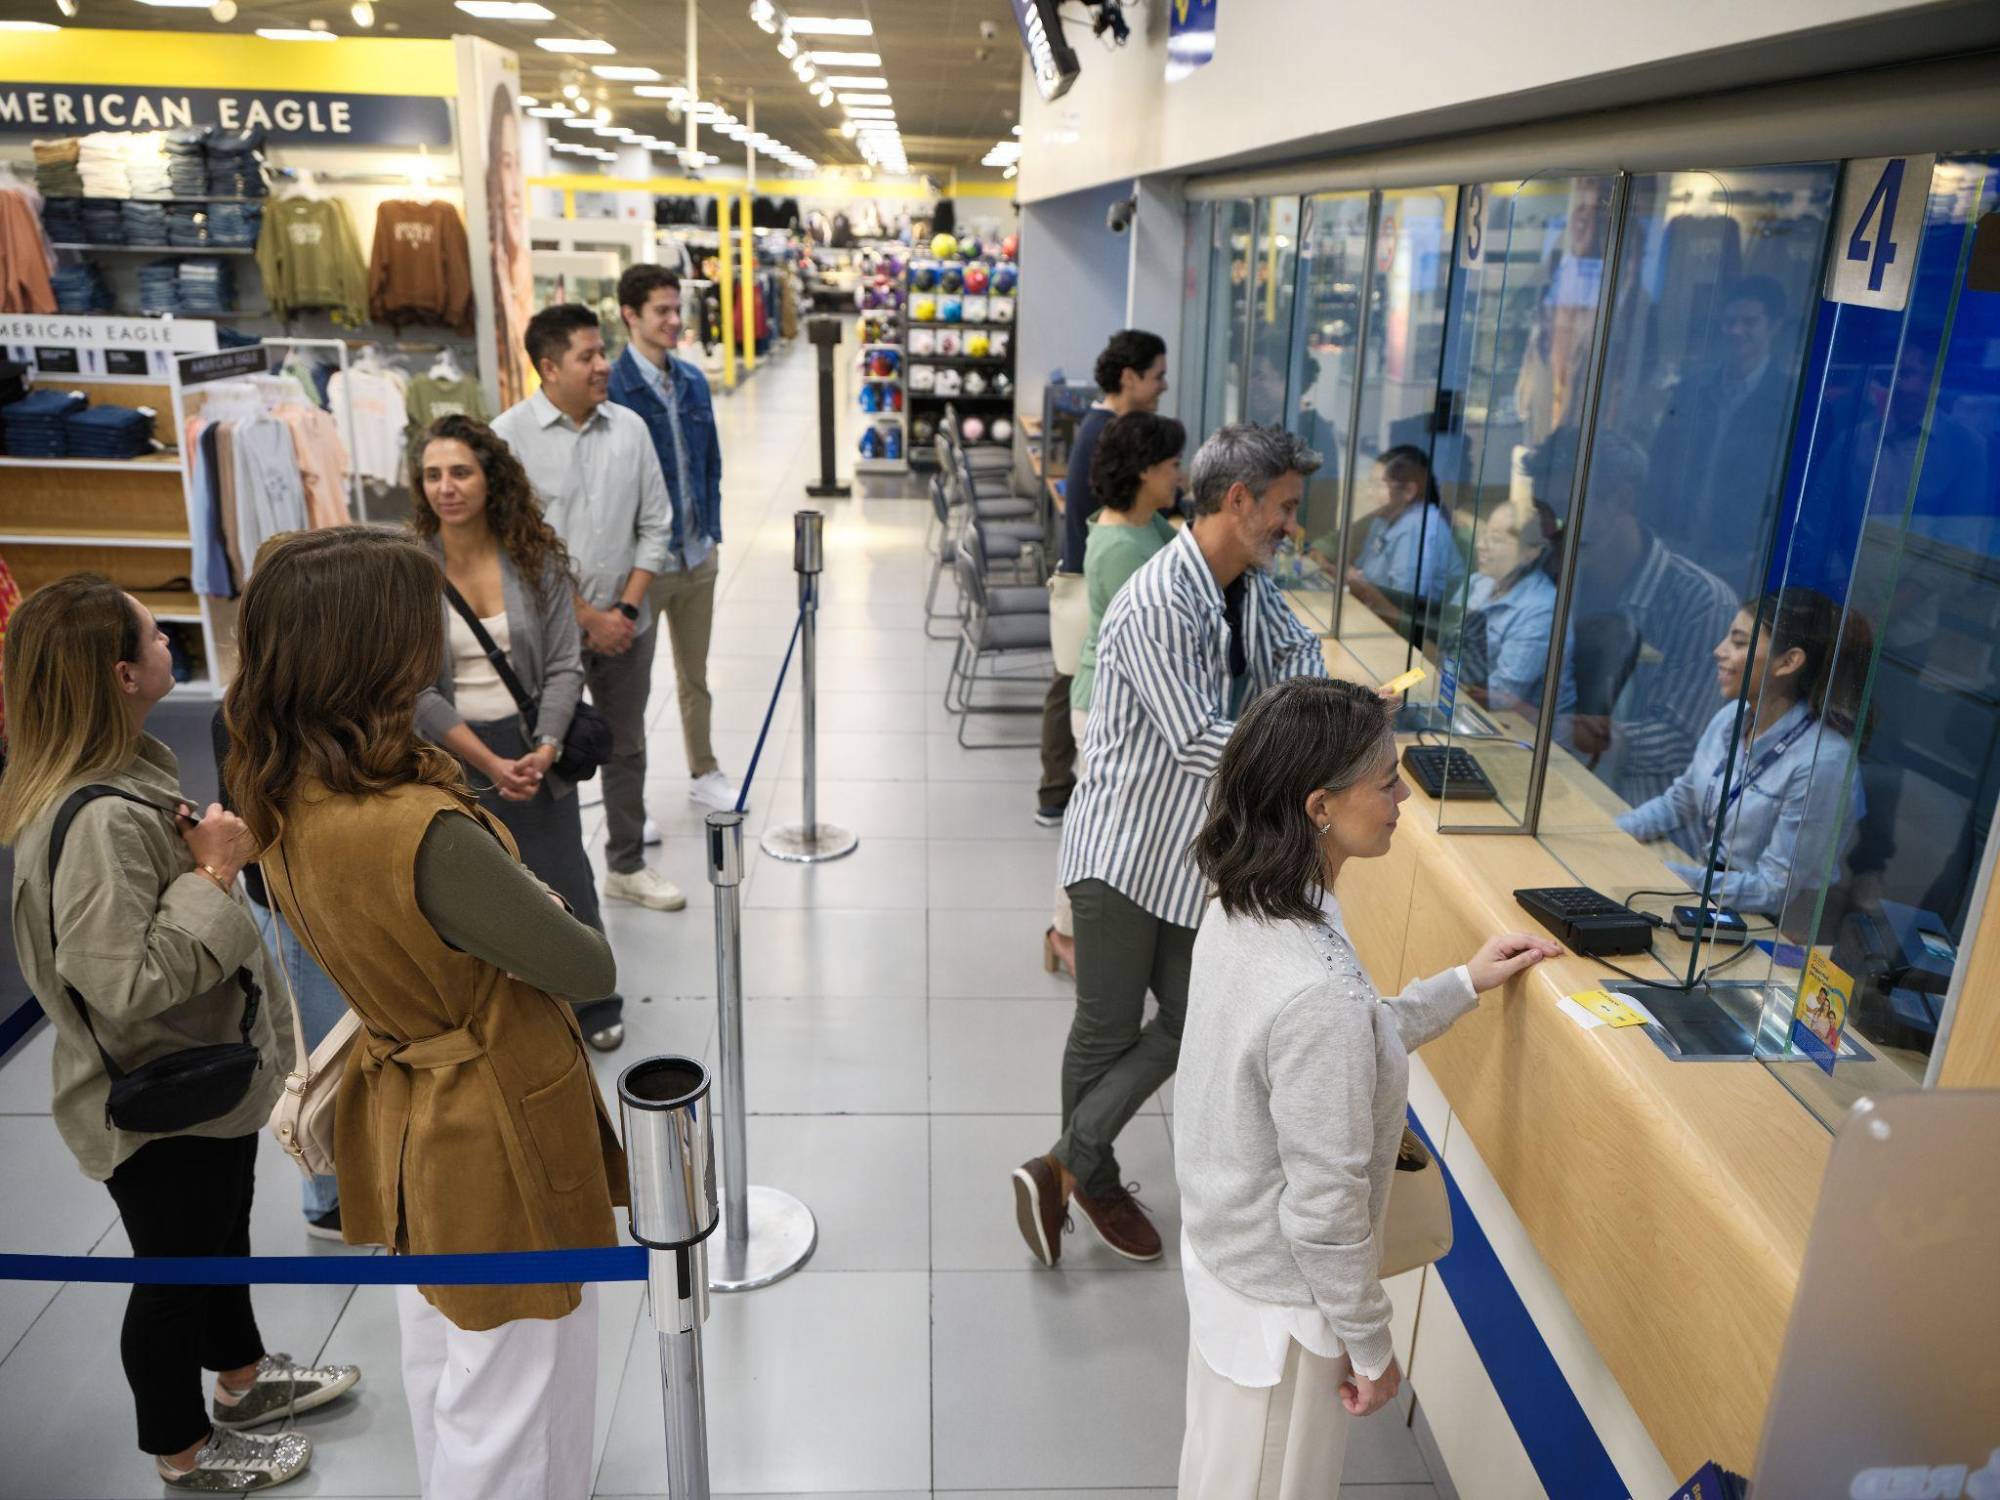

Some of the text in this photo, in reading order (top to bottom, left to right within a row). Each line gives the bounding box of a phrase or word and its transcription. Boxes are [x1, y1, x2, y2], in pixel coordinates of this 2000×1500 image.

[217, 97, 352, 133] EAGLE
[1467, 184, 1482, 261] 3
[1847, 159, 1906, 291] 4
[106, 324, 174, 342] EAGLE
